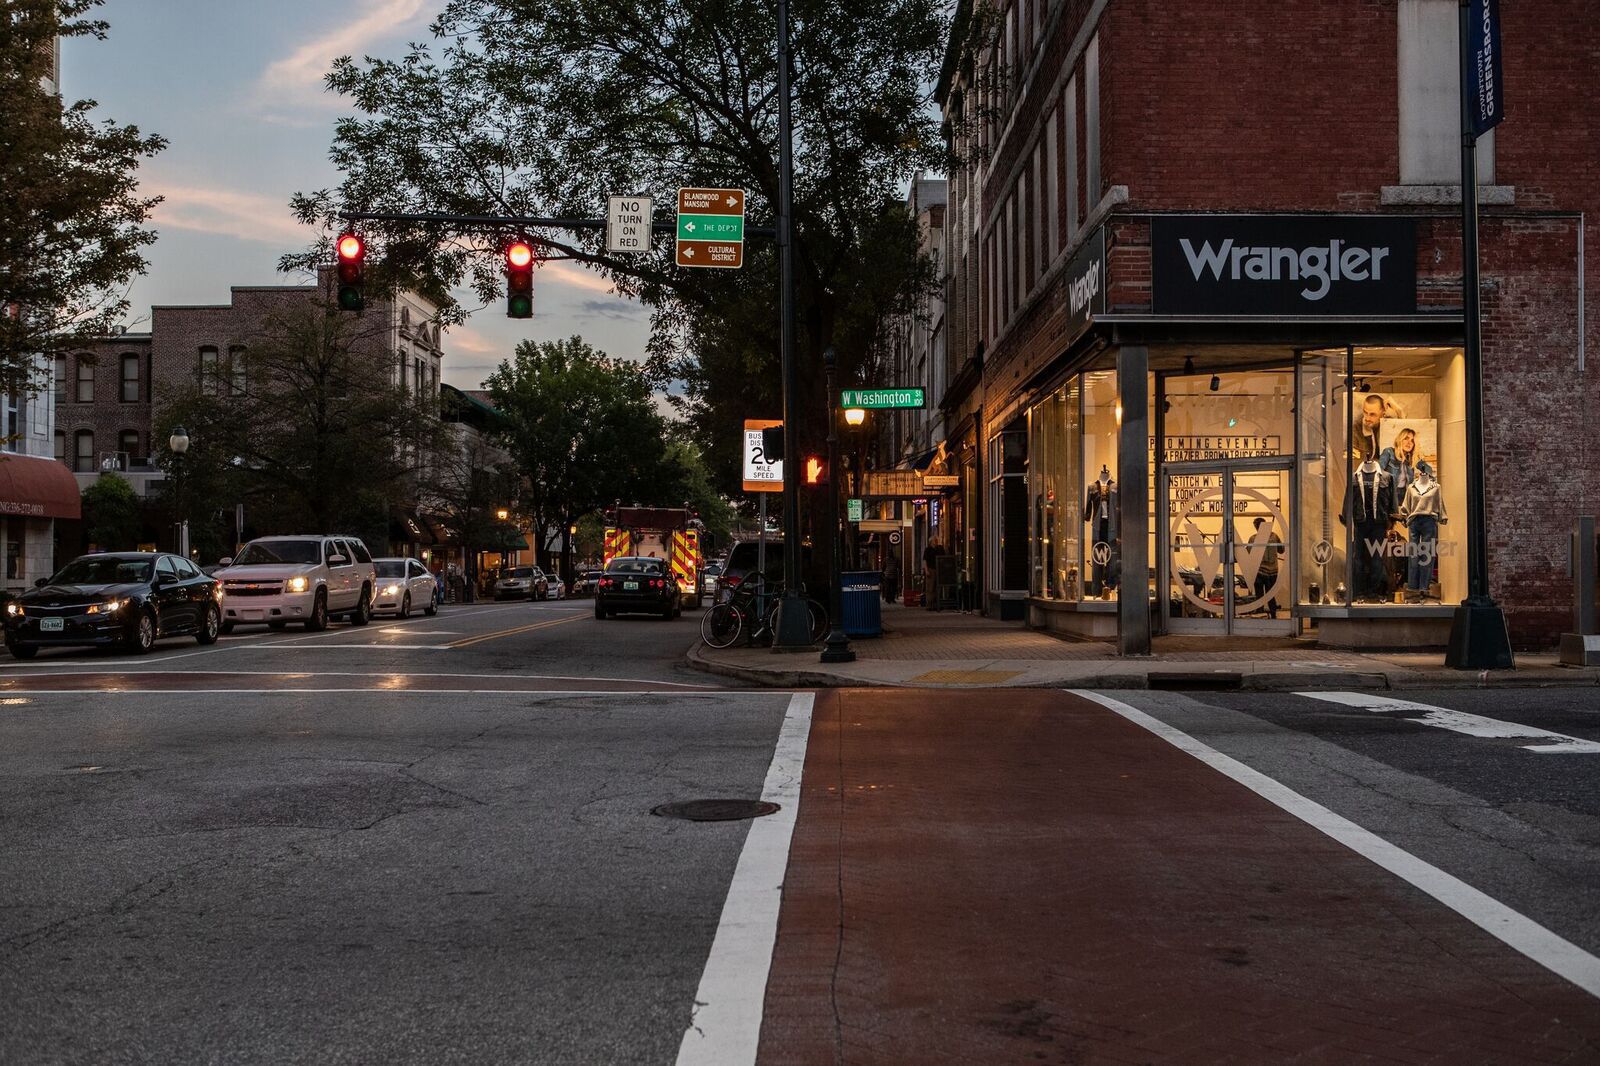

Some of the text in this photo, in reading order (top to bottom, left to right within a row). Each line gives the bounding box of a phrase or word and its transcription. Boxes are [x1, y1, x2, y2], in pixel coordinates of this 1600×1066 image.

[684, 192, 720, 201] BLANDWOOD
[620, 202, 640, 212] NO
[684, 200, 710, 208] MANSION
[618, 215, 642, 224] TURN
[622, 226, 636, 236] ON
[704, 224, 715, 232] THE
[619, 238, 638, 247] RED
[707, 246, 736, 254] CULTURAL
[711, 254, 737, 262] DISTRICT
[1179, 238, 1389, 301] Wrangler
[1068, 258, 1100, 321] Wrangler
[842, 391, 851, 405] W
[855, 390, 911, 407] Washington
[1217, 438, 1267, 449] EVENTS
[1175, 489, 1203, 500] KOONC
[1364, 538, 1458, 567] Wrangler
